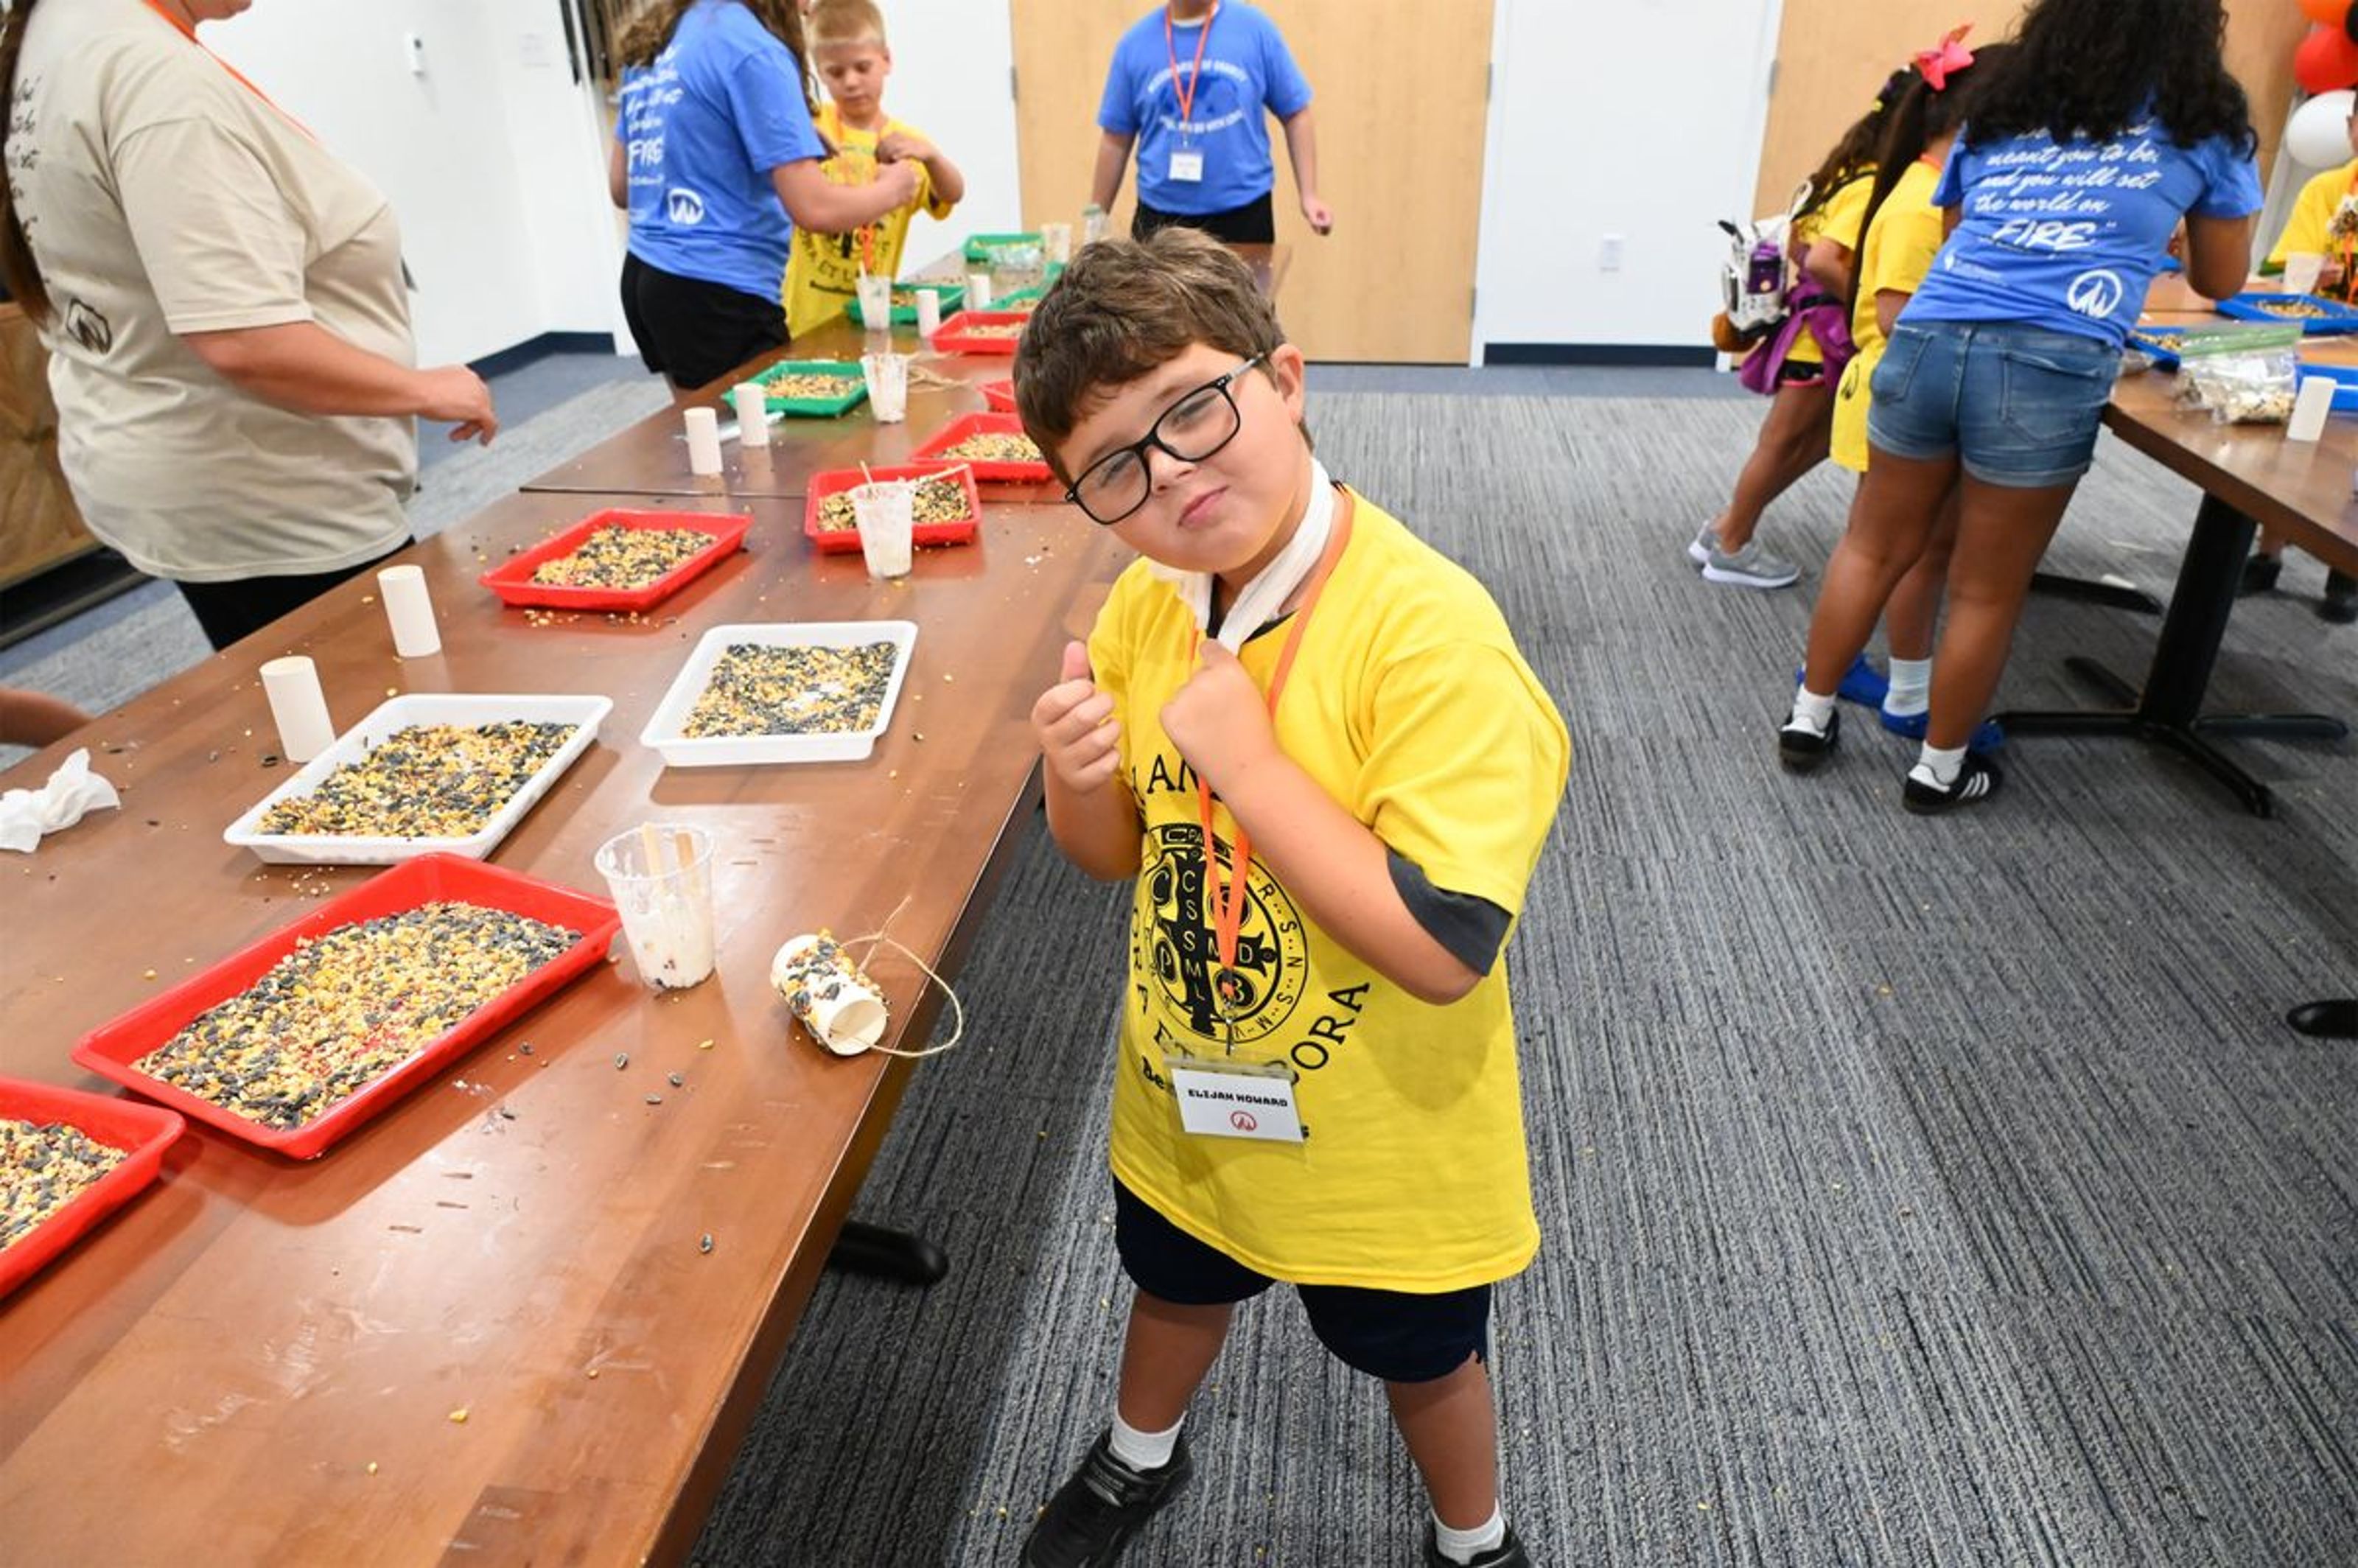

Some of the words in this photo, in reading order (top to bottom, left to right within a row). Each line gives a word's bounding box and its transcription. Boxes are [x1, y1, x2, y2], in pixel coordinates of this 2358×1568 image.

[1987, 146, 2061, 167] meant
[2047, 149, 2099, 172] you
[2100, 143, 2127, 162] to
[2009, 174, 2062, 197] you
[2061, 166, 2120, 187] will
[2116, 170, 2163, 190] set
[1973, 192, 2010, 214] the
[2009, 189, 2085, 212] world
[2077, 198, 2112, 214] on
[1187, 1088, 1234, 1102] ELIJAH
[1235, 1093, 1288, 1107] HOWARD
